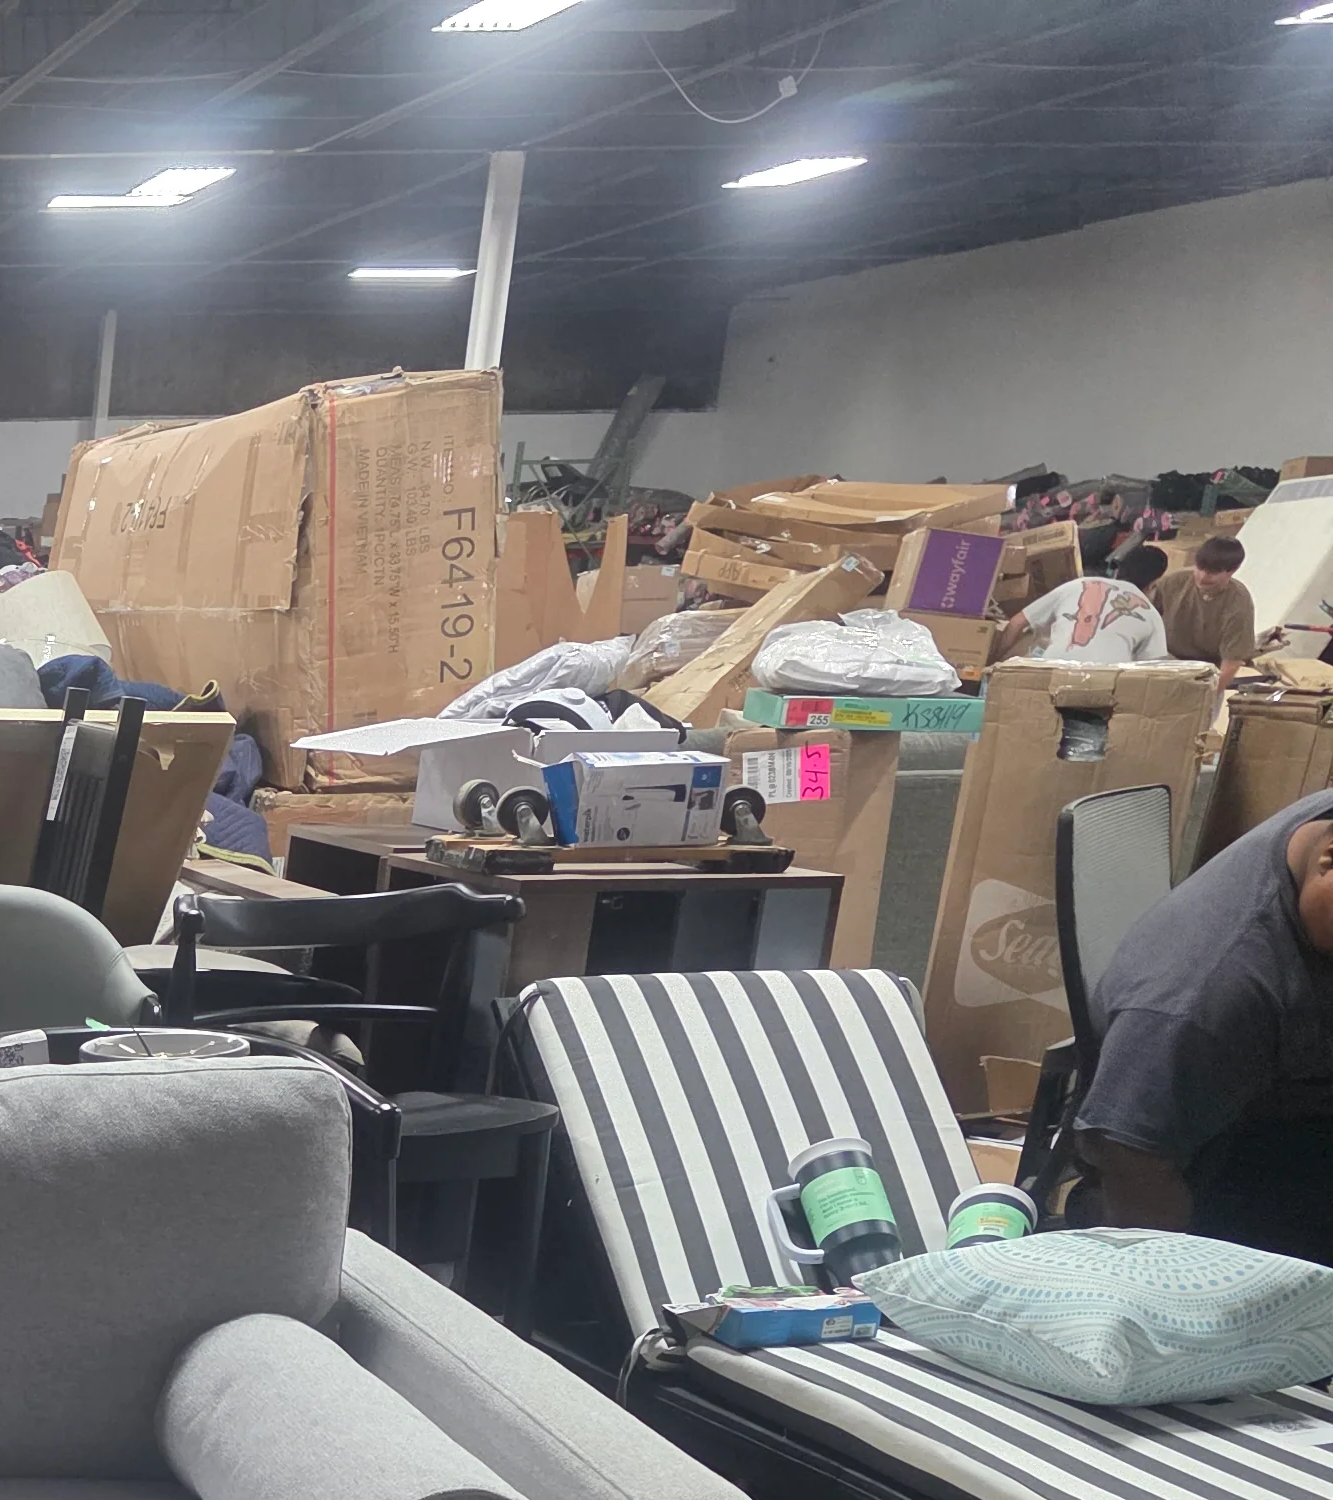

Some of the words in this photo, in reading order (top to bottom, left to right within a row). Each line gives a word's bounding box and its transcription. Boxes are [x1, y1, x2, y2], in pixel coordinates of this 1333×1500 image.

[359, 448, 370, 491] MADE
[358, 494, 370, 508] IN
[356, 511, 369, 575] VIETNAM
[405, 530, 417, 557] LBS
[419, 527, 430, 554] LBS
[945, 538, 971, 597] wayfair
[439, 506, 477, 684] F6419-2
[810, 714, 829, 726] 255
[801, 740, 829, 800] 34.5
[978, 918, 1061, 979] Sea
